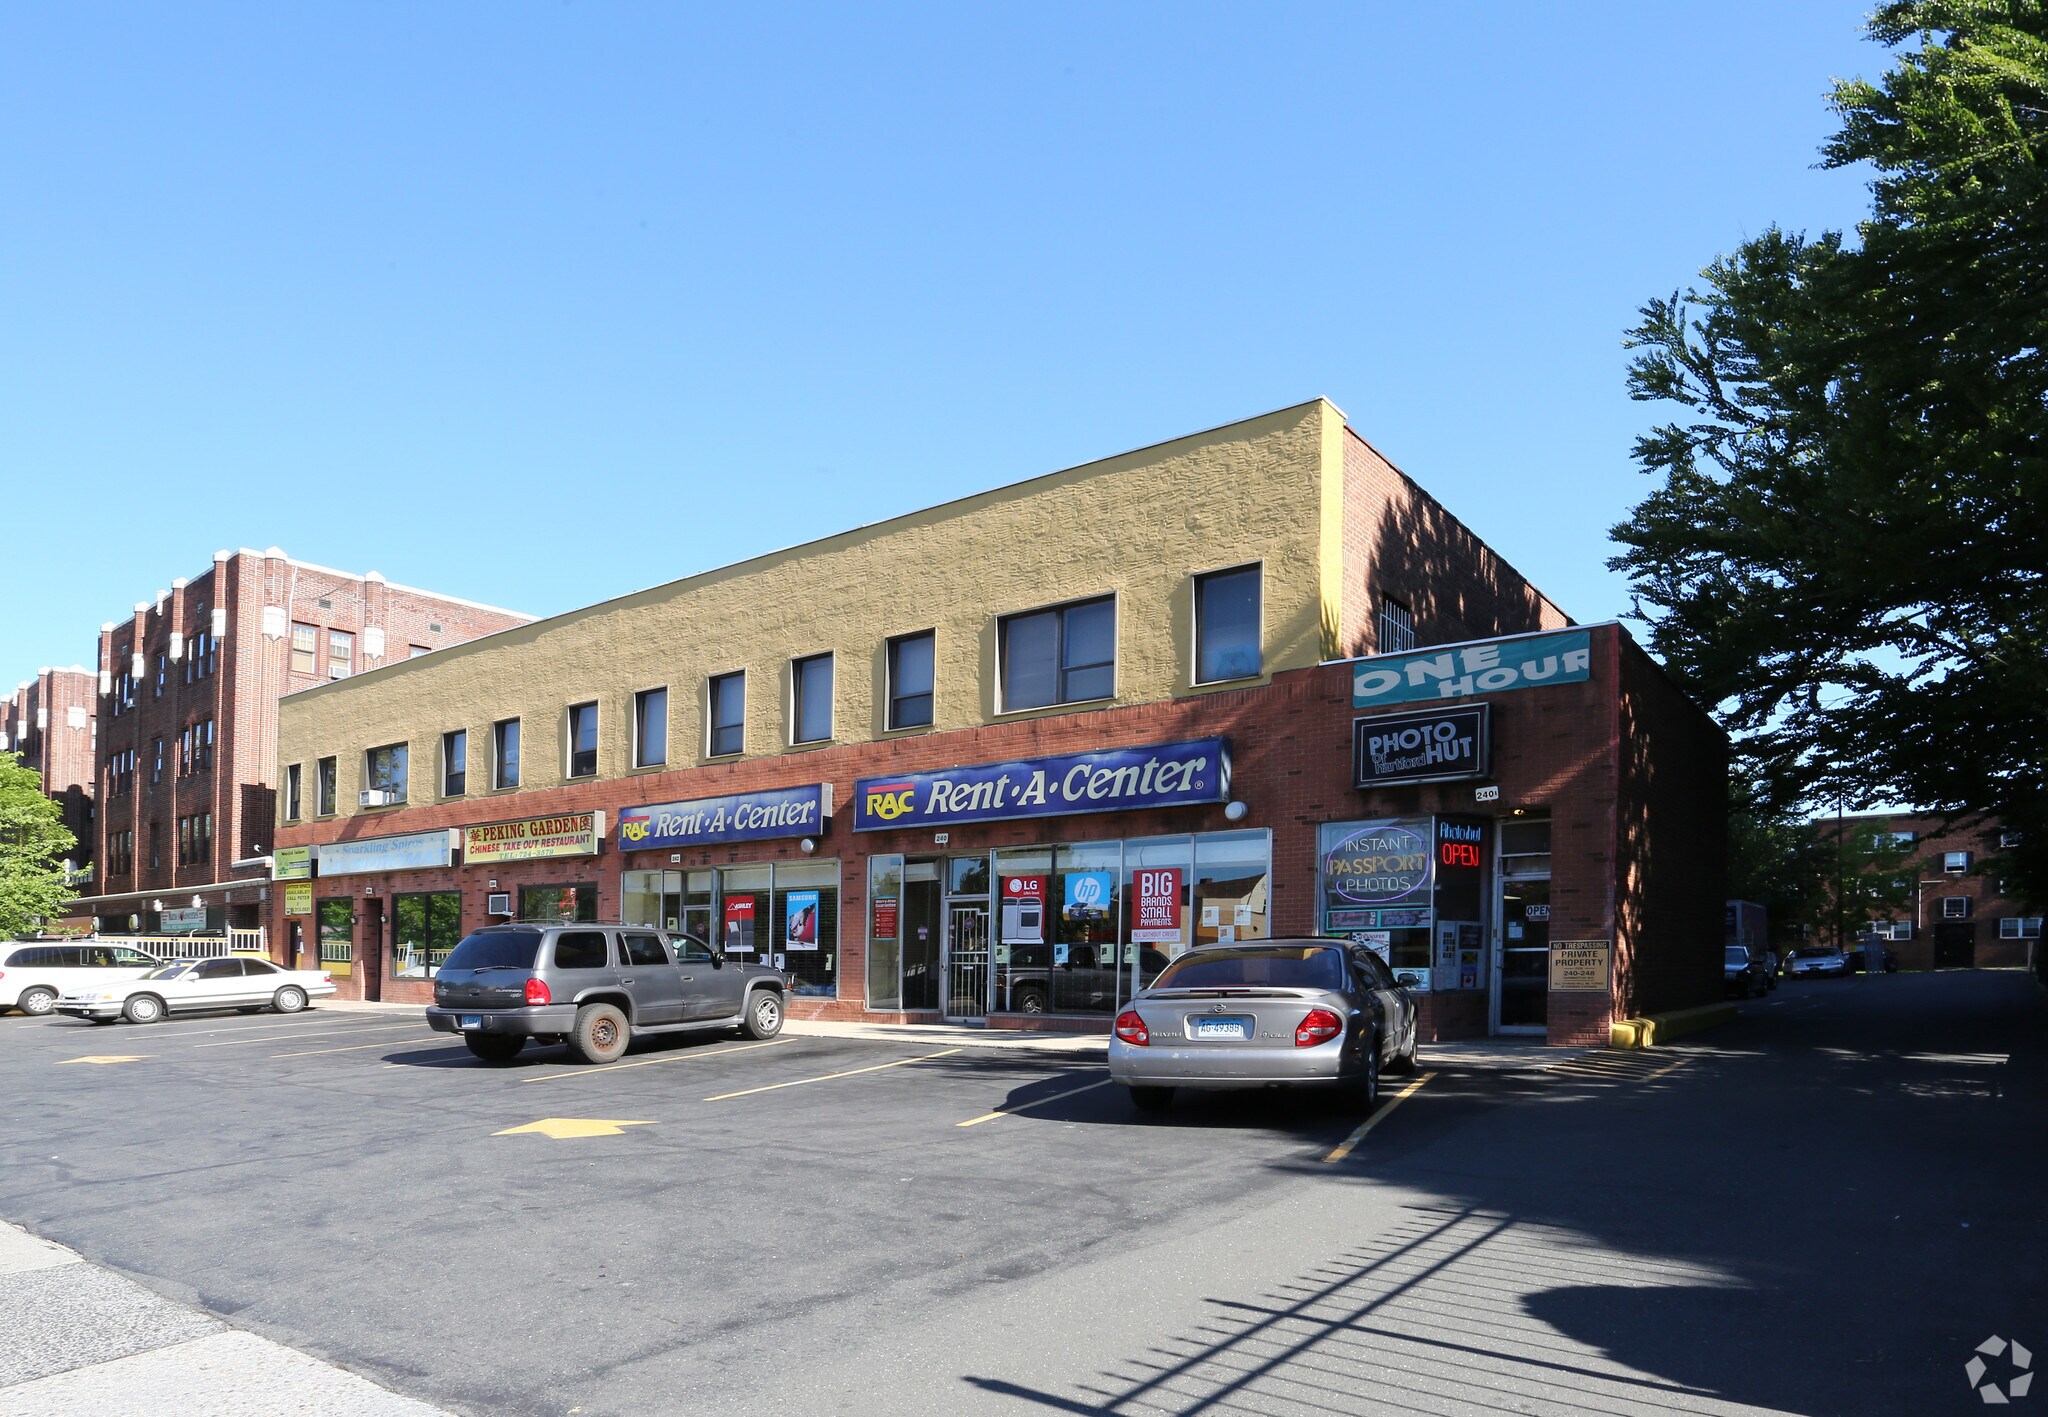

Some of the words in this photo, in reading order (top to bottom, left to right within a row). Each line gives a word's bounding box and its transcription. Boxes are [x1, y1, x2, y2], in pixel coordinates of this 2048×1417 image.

[1354, 644, 1501, 697] ONE
[1438, 648, 1589, 697] HOUR
[1369, 721, 1457, 756] PHOTO
[1372, 752, 1387, 763] of
[1425, 737, 1472, 764] HUT
[1374, 752, 1427, 775] hartford
[866, 791, 915, 820] RAC
[483, 822, 525, 841] PEKING
[530, 816, 579, 836] GARDEN
[622, 820, 650, 842] RAC
[470, 843, 500, 855] CHINESE
[503, 841, 521, 851] TAKE
[523, 839, 539, 850] OUT
[541, 834, 591, 848] RESTAURANT
[1345, 835, 1411, 852] INSTANT
[1330, 853, 1426, 875] PASSPORT
[1442, 843, 1479, 867] OPEN
[1023, 880, 1038, 890] LG
[1078, 878, 1098, 901] hp
[1141, 872, 1173, 897] BIG
[1346, 876, 1411, 892] PHOTOS
[727, 902, 753, 911] ASHLEY
[1141, 896, 1173, 907] BRANDS.
[1141, 906, 1172, 918] SMALL
[1526, 906, 1551, 915] OPEN
[1555, 958, 1604, 966] PROPERTY
[1561, 950, 1598, 958] PRIVATE
